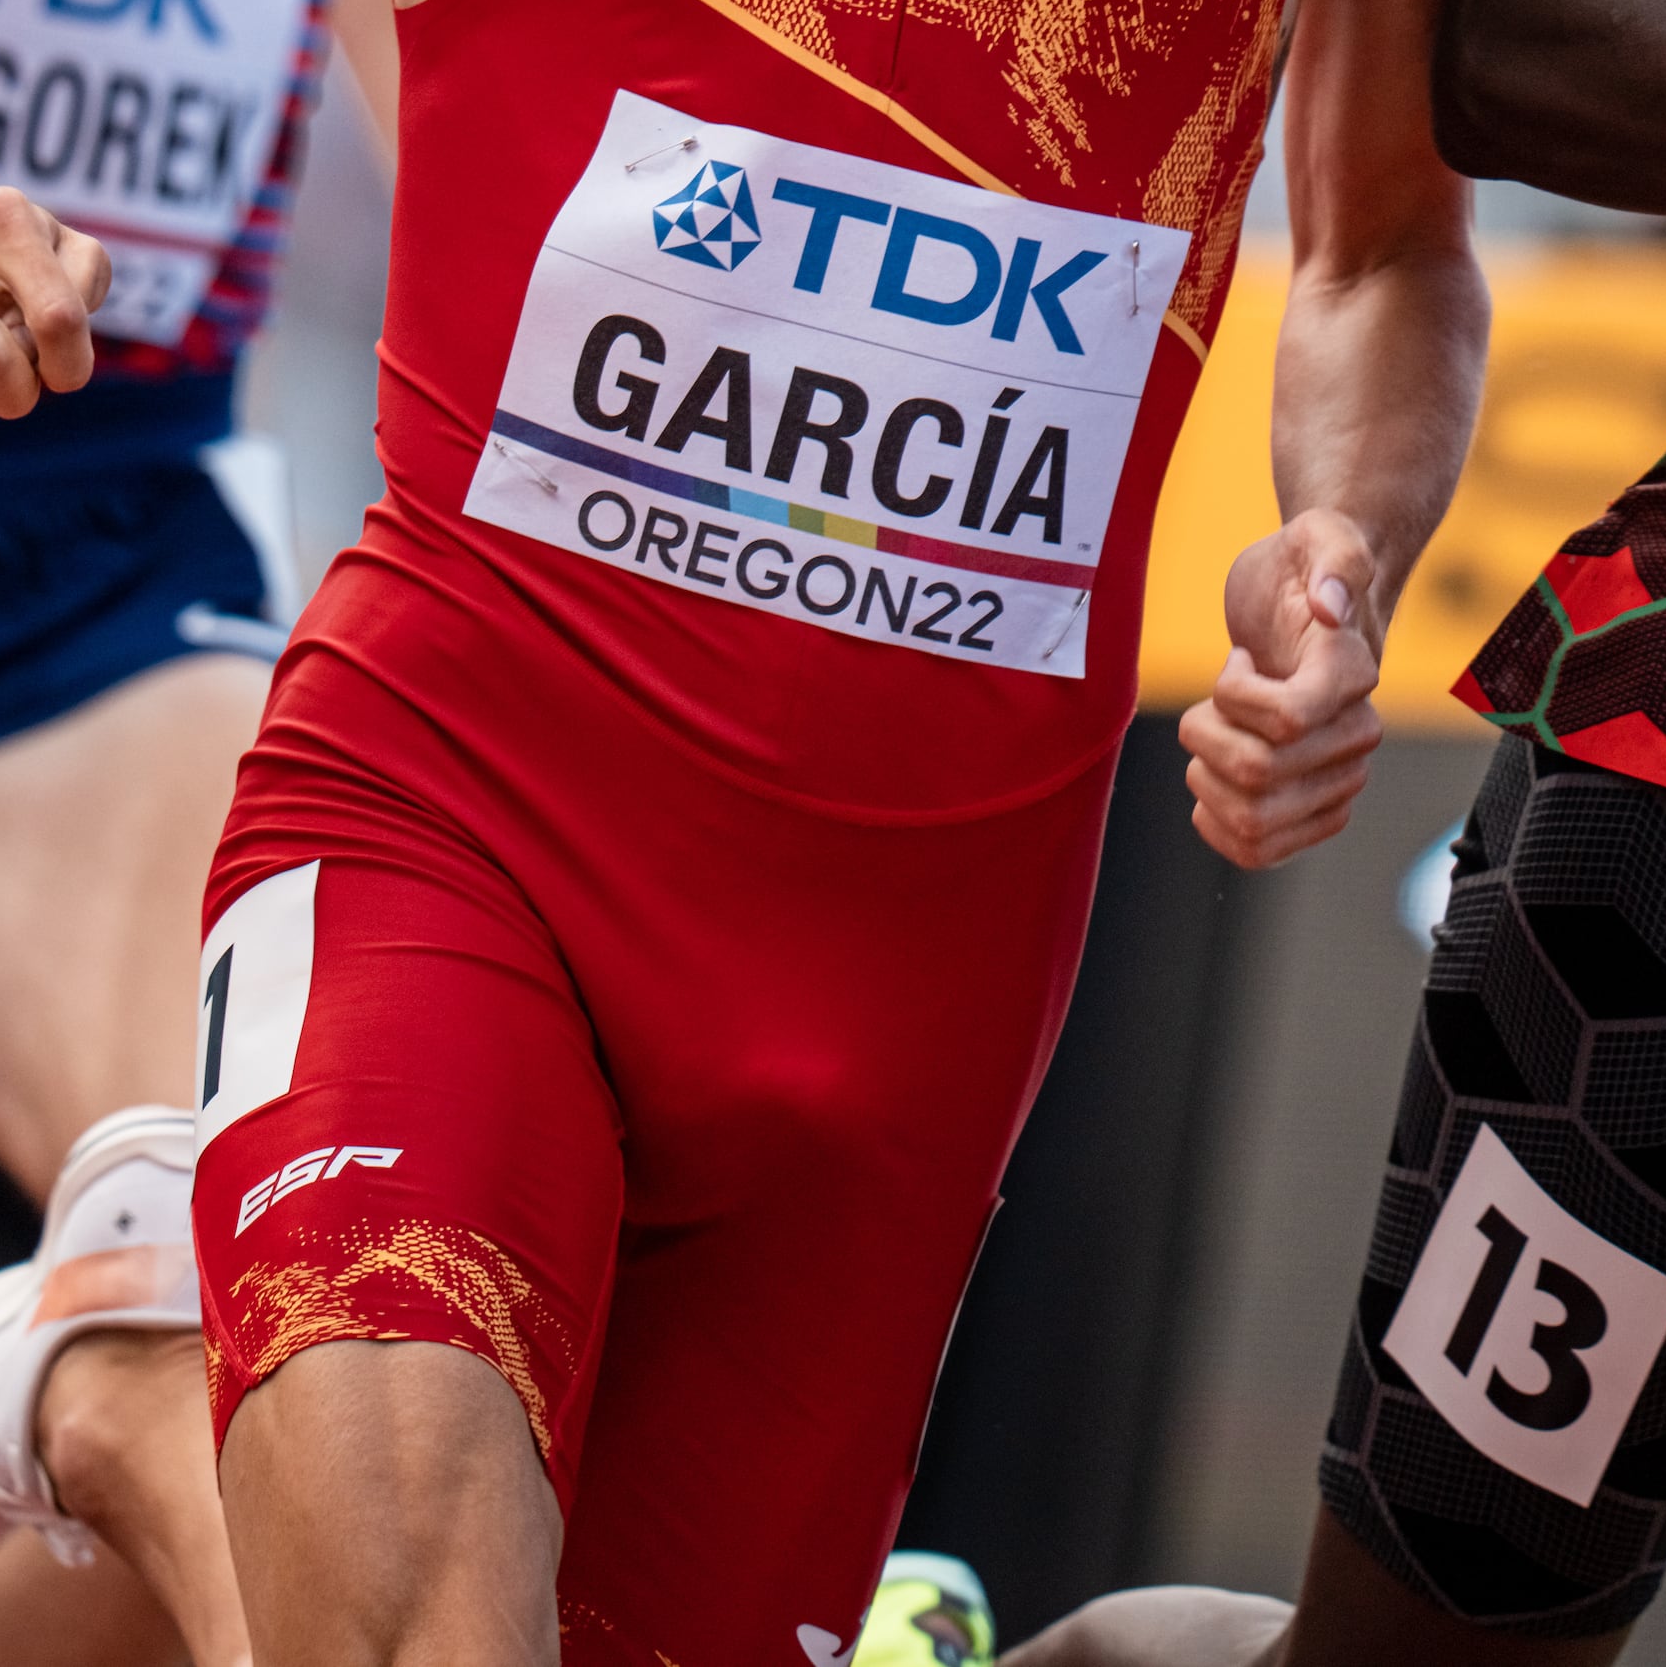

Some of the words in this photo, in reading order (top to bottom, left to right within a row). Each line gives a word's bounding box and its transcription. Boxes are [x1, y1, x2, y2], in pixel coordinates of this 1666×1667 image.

[771, 178, 1110, 356] TDK
[571, 313, 1071, 545] GARCÍA
[577, 489, 1005, 652] OREGON22
[234, 1145, 404, 1240] ESP
[1444, 1204, 1607, 1431] 13
